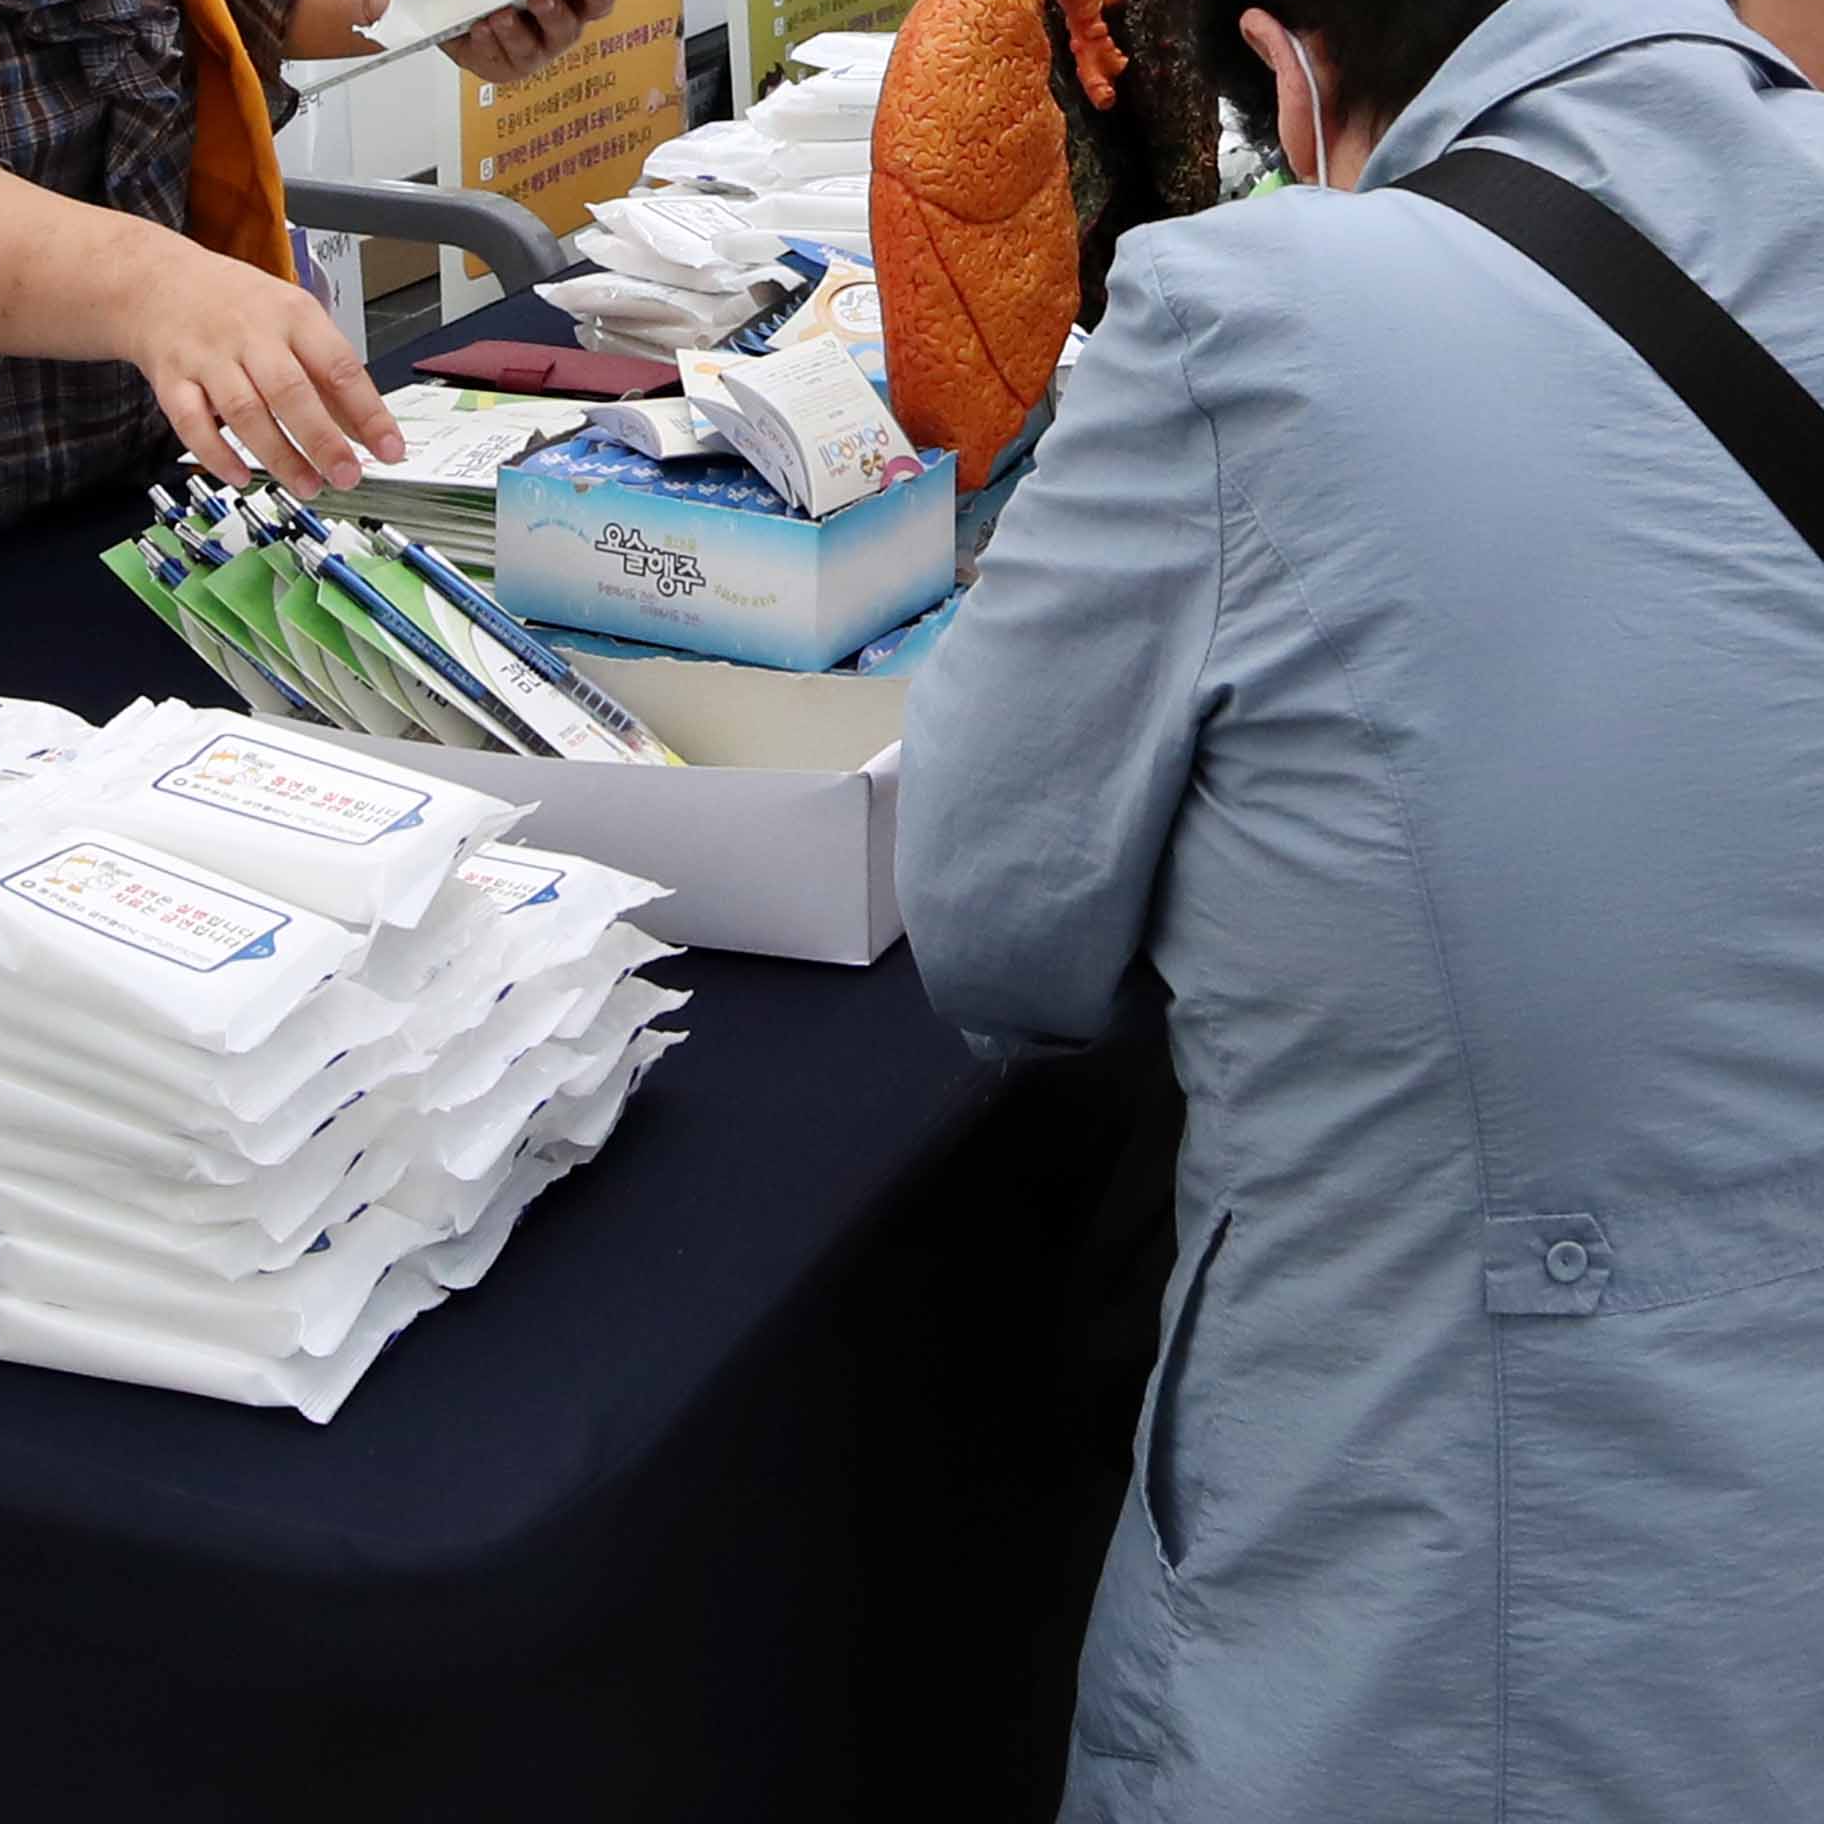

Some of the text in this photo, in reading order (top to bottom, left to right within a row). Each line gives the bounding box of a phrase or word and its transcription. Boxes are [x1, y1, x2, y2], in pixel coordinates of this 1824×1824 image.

[594, 522, 707, 597] 요술행주
[160, 911, 242, 950] 금연입니다
[176, 902, 256, 940] 질병입니다
